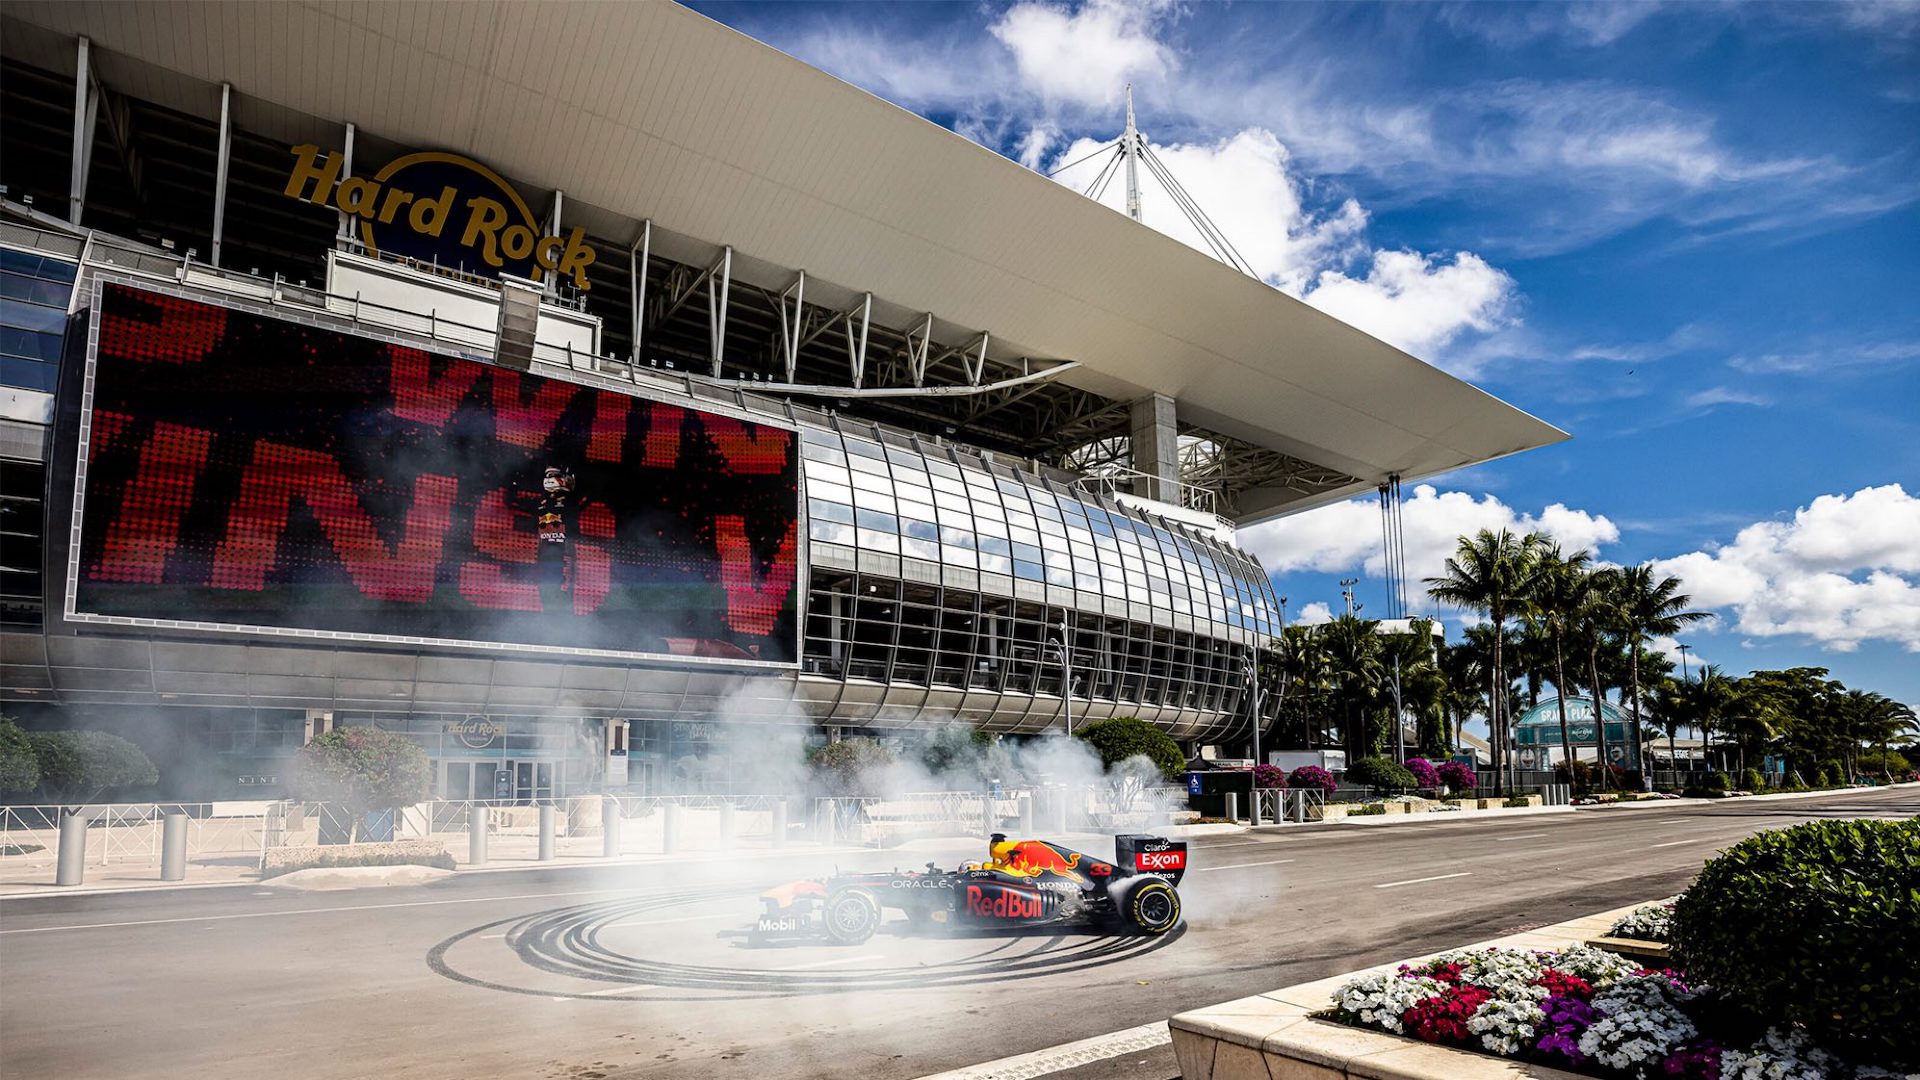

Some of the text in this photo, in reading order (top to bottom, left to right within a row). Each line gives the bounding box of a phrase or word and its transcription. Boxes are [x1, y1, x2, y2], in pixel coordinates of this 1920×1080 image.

[284, 144, 597, 291] Hard Rock
[1144, 843, 1168, 852] Claro
[1142, 853, 1180, 869] Exxon
[1089, 863, 1113, 876] 33
[892, 880, 947, 889] ORACLE
[1036, 881, 1080, 891] HONDA
[759, 918, 796, 932] Mobil
